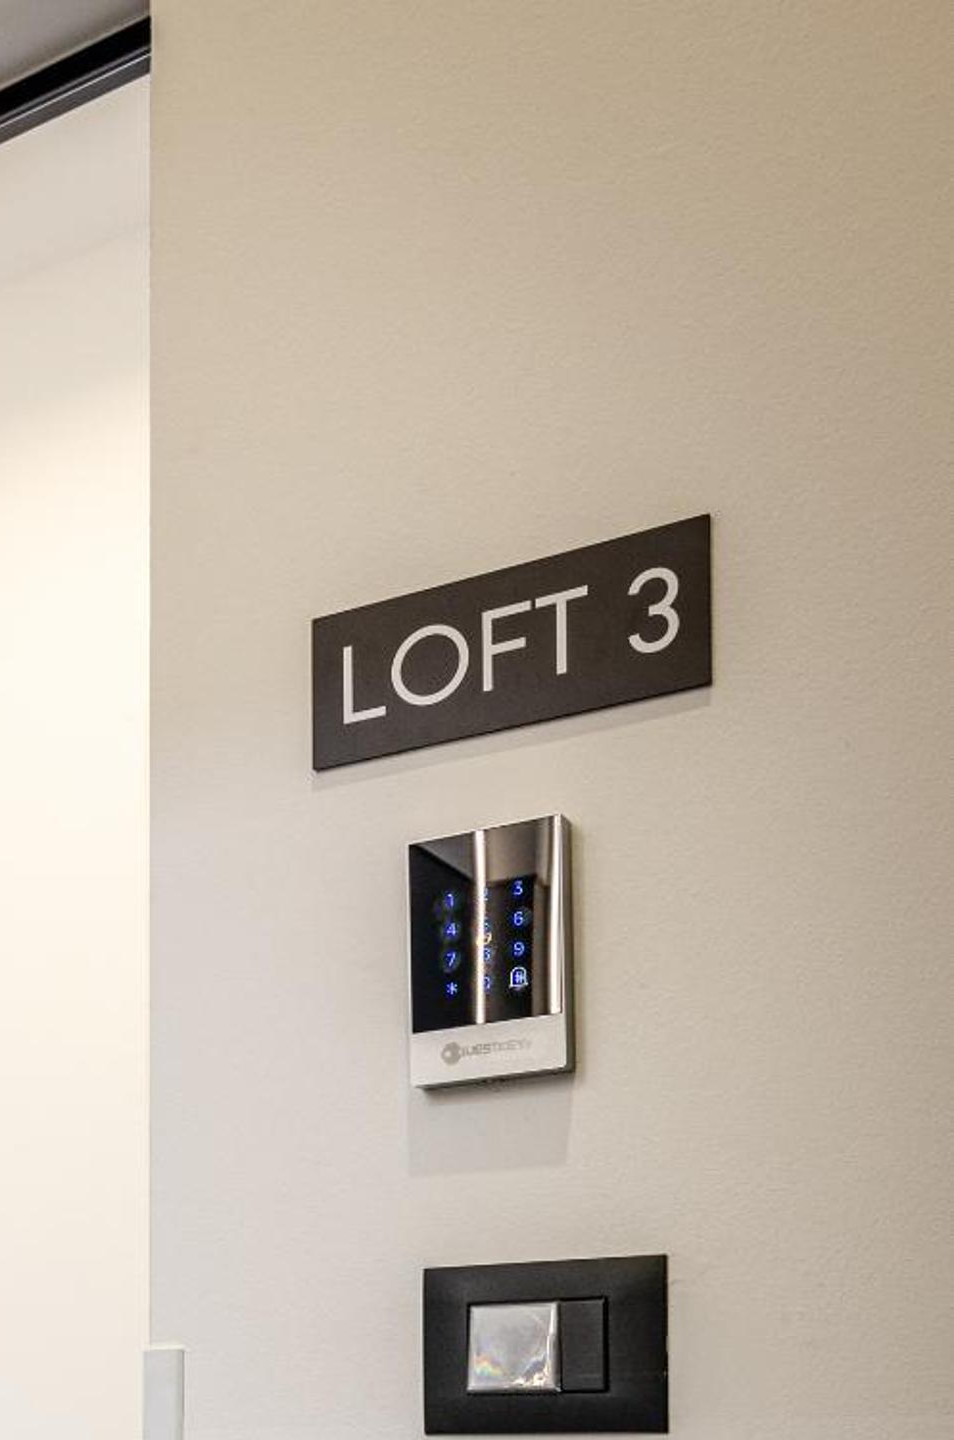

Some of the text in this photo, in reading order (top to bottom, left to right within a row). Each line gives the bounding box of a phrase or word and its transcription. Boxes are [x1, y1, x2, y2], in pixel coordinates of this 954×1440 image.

[343, 567, 681, 724] LOFT 3
[513, 911, 524, 926] 6
[446, 922, 456, 936] 4
[513, 941, 525, 956] 9
[446, 951, 456, 967] 7
